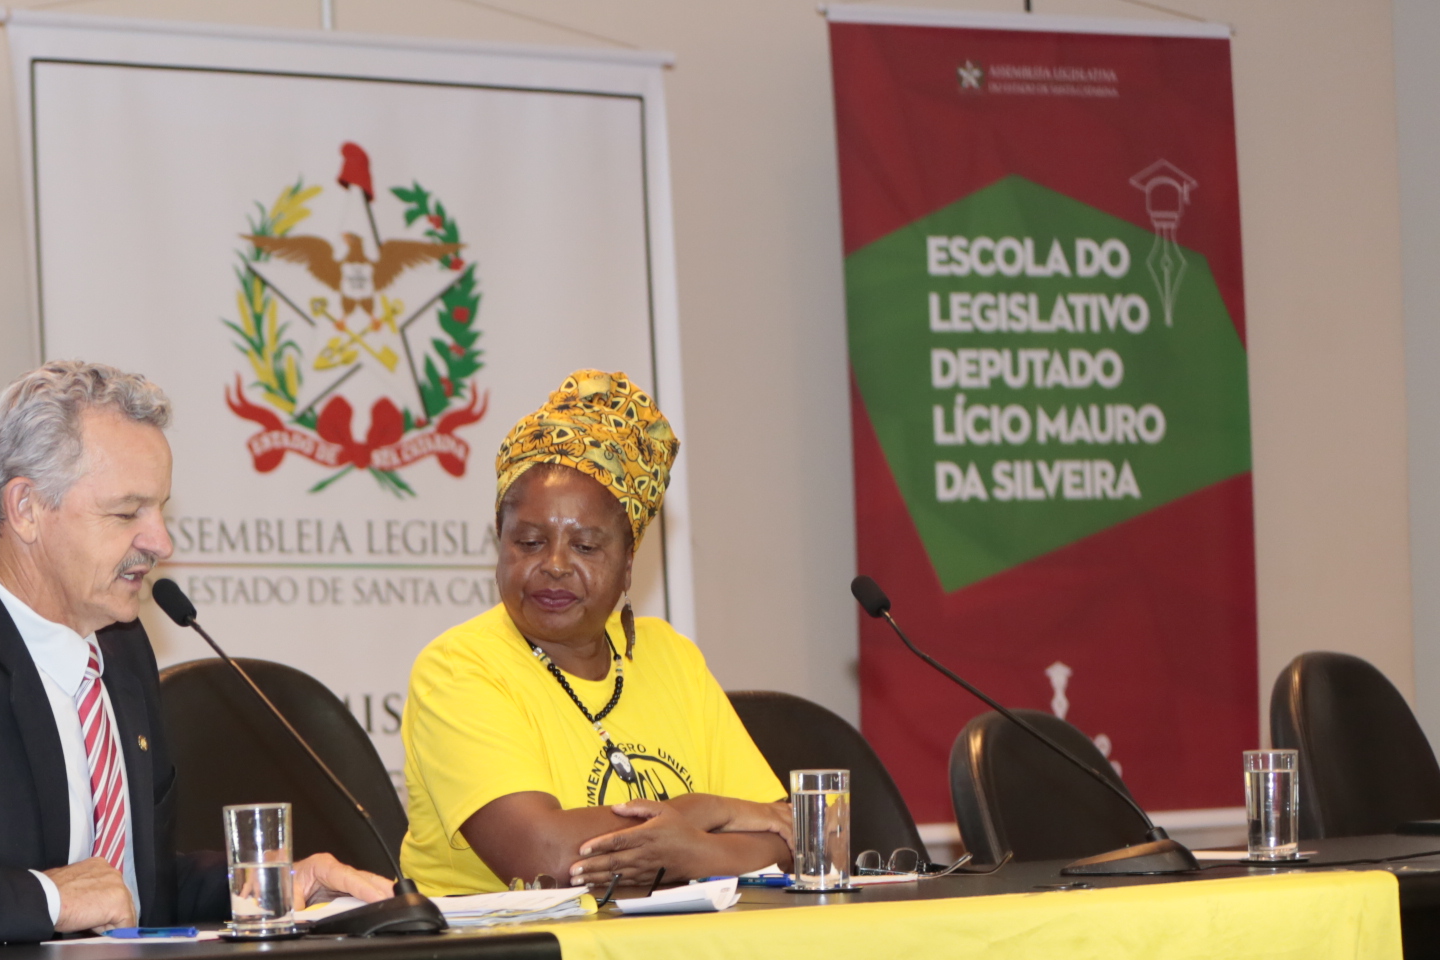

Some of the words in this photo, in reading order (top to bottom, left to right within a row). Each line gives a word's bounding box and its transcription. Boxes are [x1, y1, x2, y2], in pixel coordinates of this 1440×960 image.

[926, 235, 1071, 277] ESCOLA
[1075, 238, 1130, 278] DO
[929, 292, 1150, 333] LEGISLATIVO
[931, 349, 1124, 388] DEPUTADO
[932, 394, 1031, 445] LÍCIO
[1036, 404, 1167, 444] MAURO
[935, 461, 988, 502] DA
[992, 459, 1141, 500] SILVEIRA
[164, 515, 353, 555] SSEMBLEIA
[366, 519, 500, 557] LEGISLA
[187, 574, 299, 606] ESTADO
[308, 576, 344, 606] DE
[352, 576, 441, 607] SANTA
[447, 577, 499, 607] CAT
